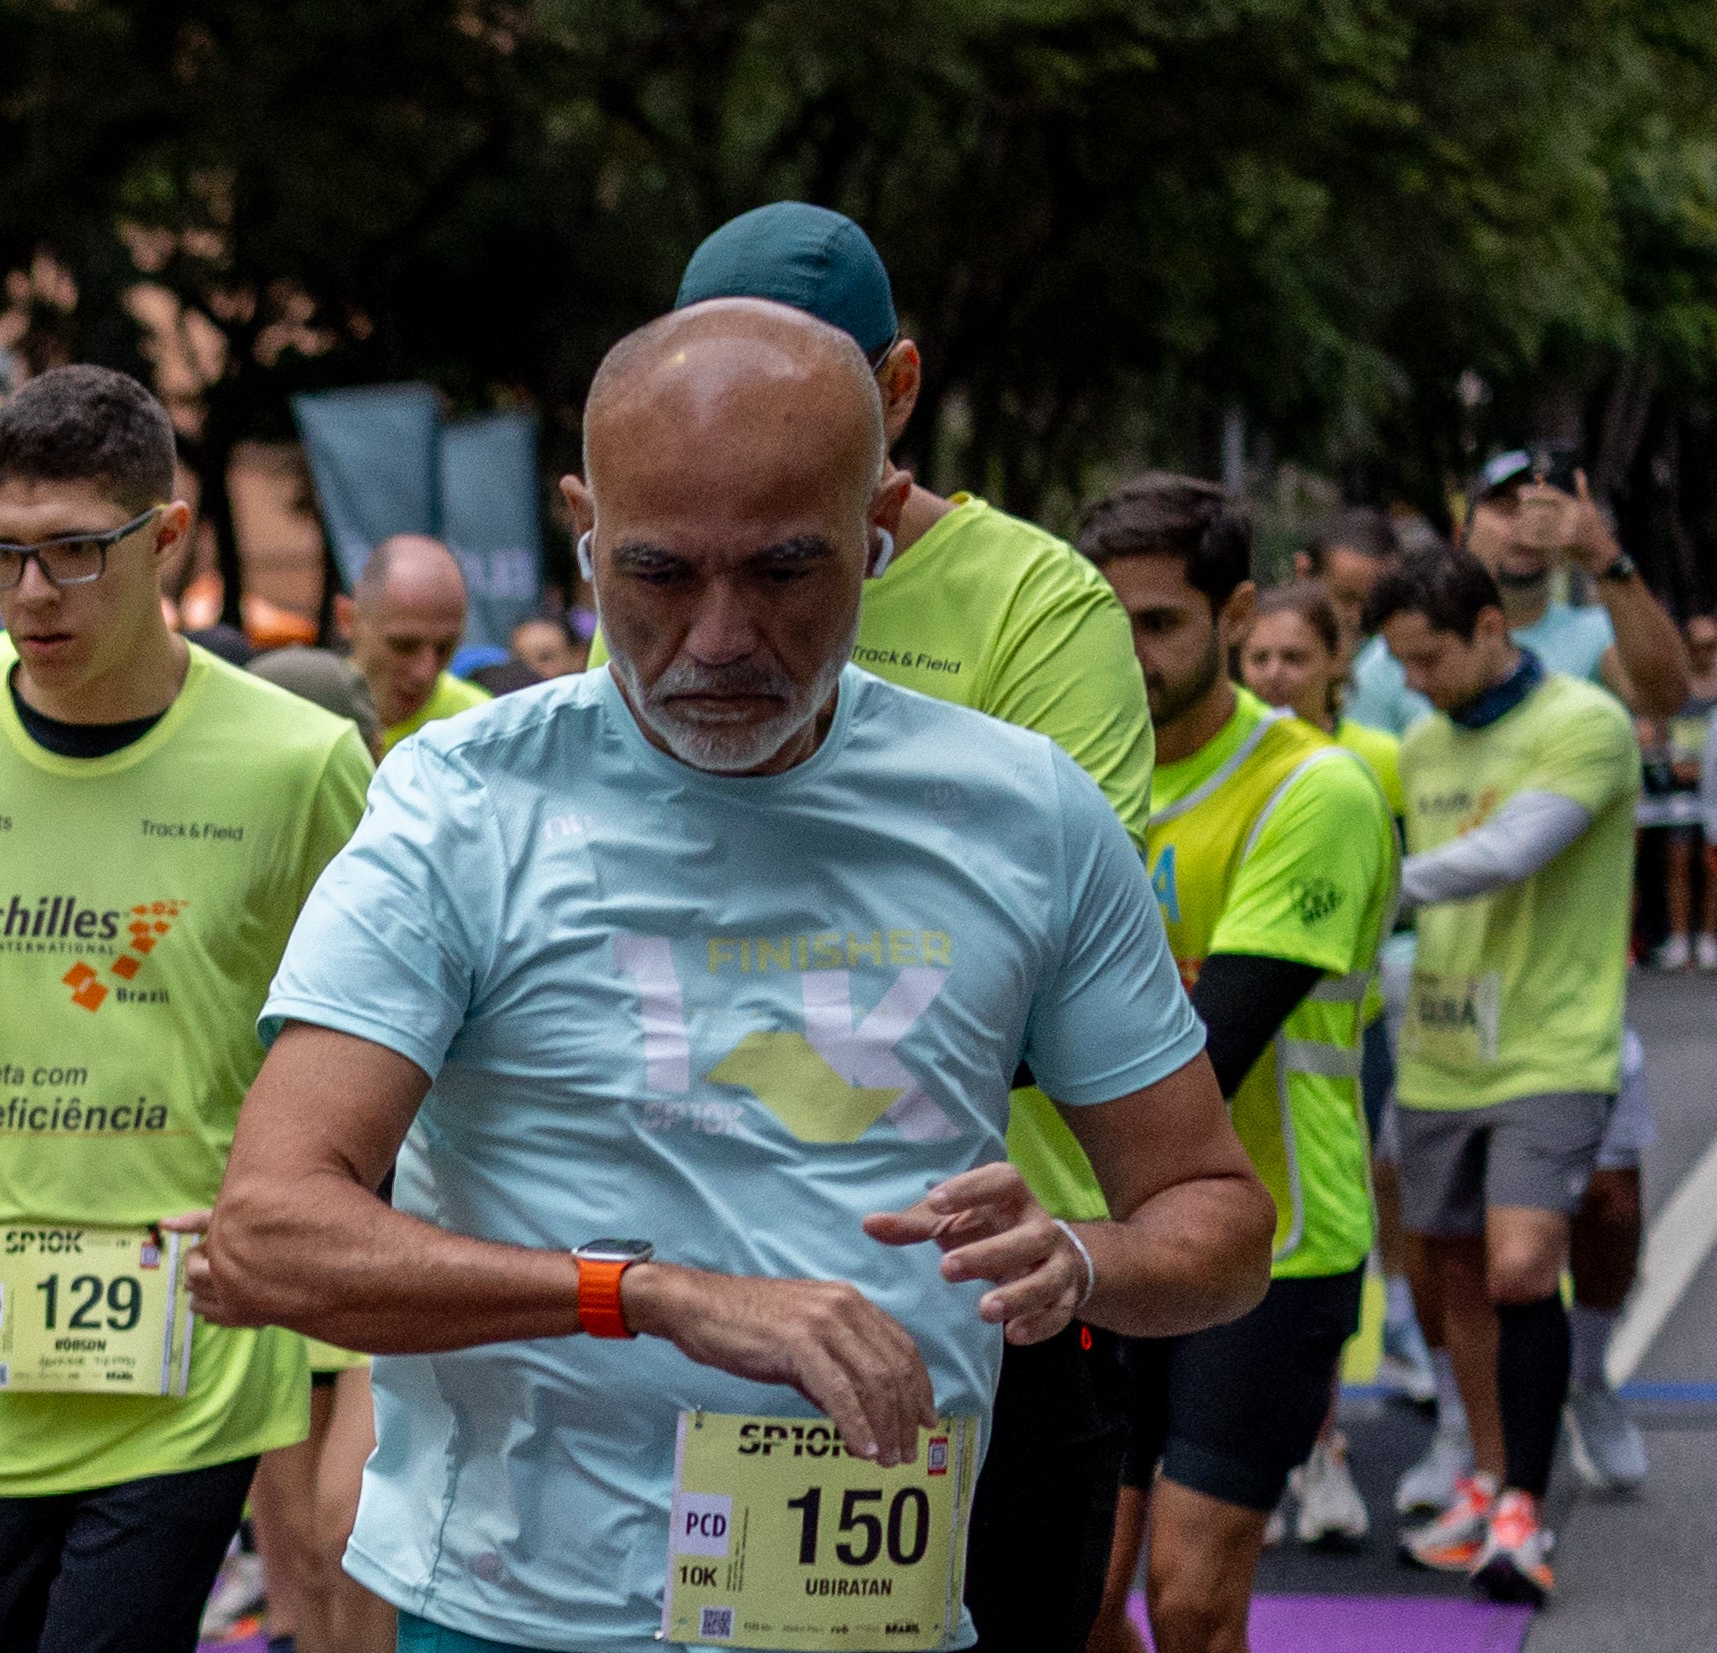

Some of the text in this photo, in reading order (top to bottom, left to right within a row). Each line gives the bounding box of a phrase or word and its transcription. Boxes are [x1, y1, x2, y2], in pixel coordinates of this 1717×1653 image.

[707, 929, 954, 974] FINISHER
[116, 987, 170, 1004] Brazil
[32, 1066, 88, 1088] com
[37, 1273, 143, 1331] 129
[686, 1511, 726, 1537] PCD
[787, 1486, 930, 1567] 150
[679, 1565, 718, 1587] 10K
[806, 1578, 893, 1597] UBIRATAN
